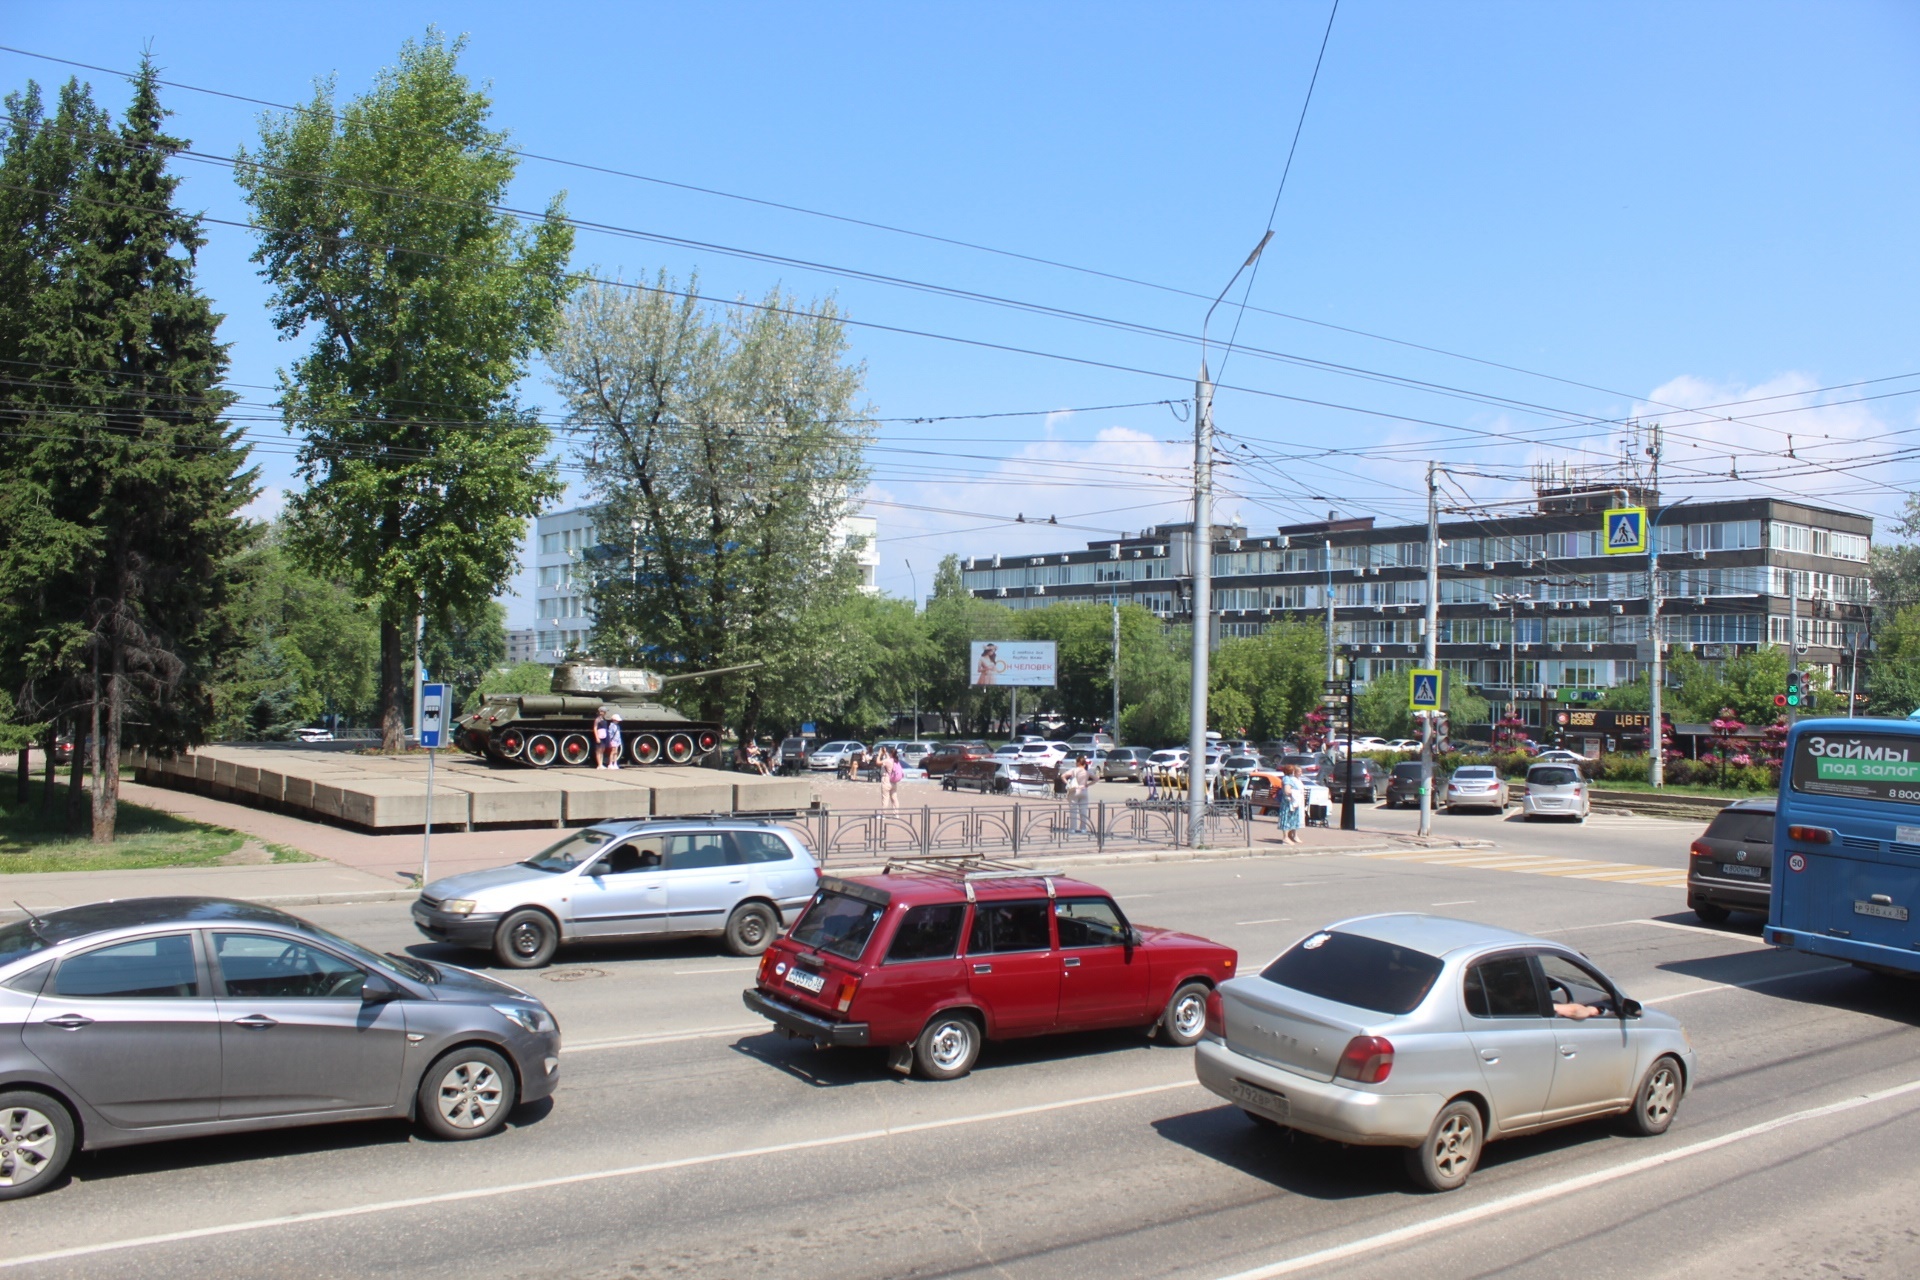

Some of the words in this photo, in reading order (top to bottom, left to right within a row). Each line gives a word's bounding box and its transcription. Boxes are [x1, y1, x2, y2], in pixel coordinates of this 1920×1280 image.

[588, 671, 609, 685] 134
[1615, 714, 1650, 727] ЦВЕТ
[1808, 737, 1909, 762] Займы
[1822, 763, 1857, 776] под
[1861, 765, 1918, 777] залог
[1888, 789, 1896, 798] 8
[1898, 790, 1920, 800] 800
[1792, 859, 1802, 868] 50
